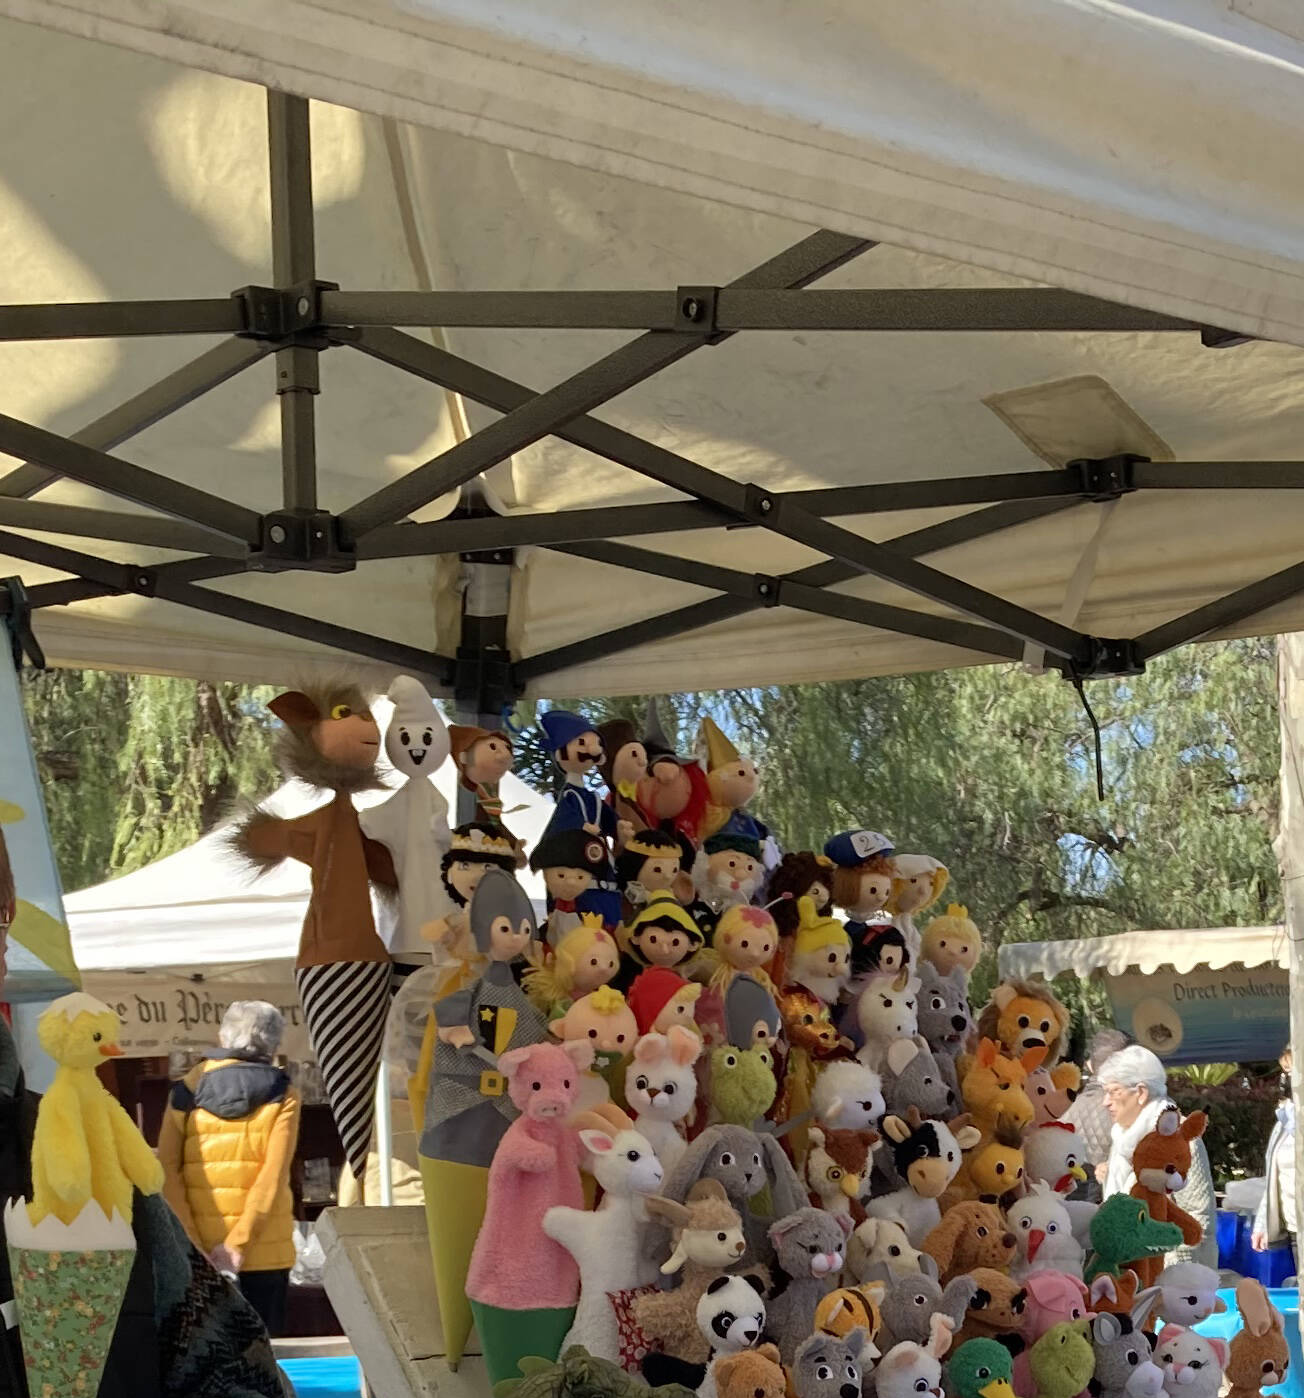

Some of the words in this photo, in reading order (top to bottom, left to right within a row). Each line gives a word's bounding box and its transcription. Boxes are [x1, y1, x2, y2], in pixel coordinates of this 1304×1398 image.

[1173, 980, 1217, 1001] Direct
[134, 993, 168, 1024] du
[175, 989, 231, 1031] Pèr
